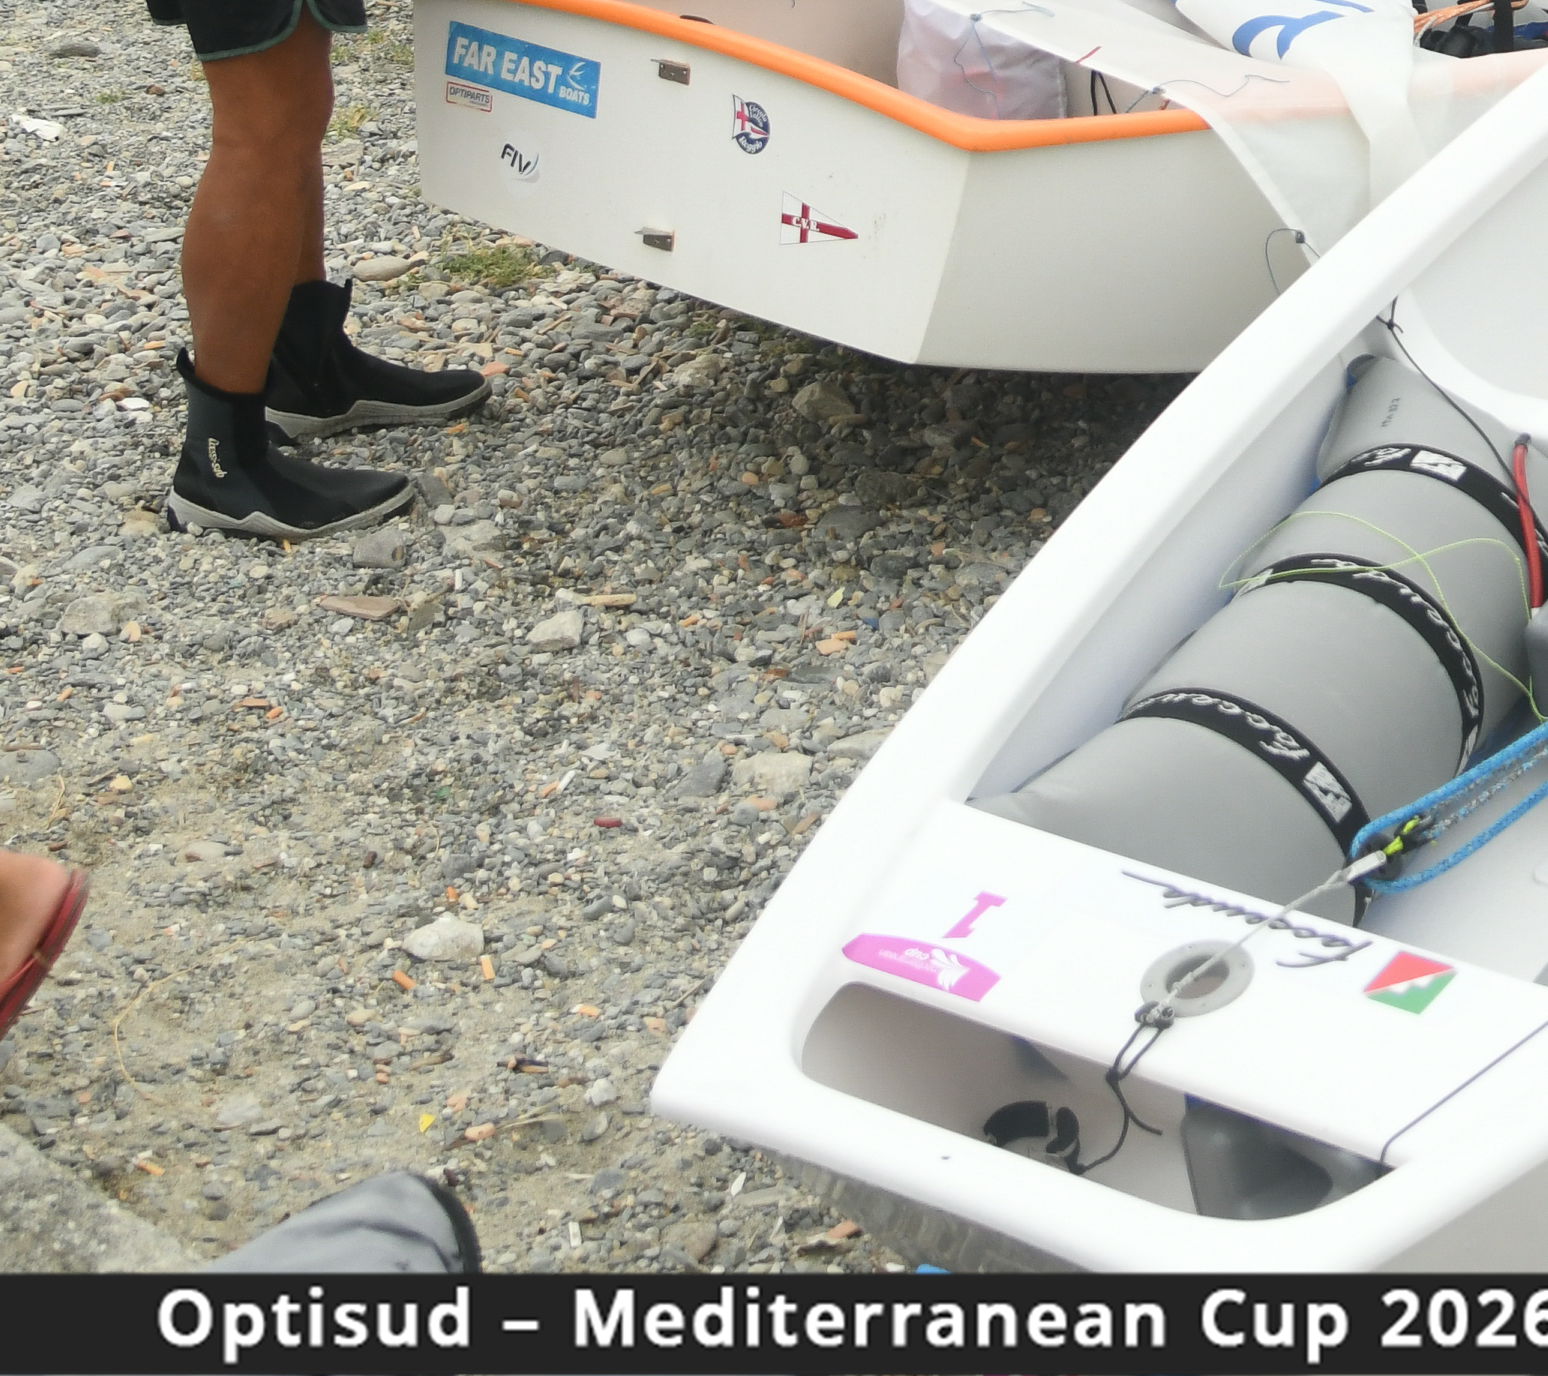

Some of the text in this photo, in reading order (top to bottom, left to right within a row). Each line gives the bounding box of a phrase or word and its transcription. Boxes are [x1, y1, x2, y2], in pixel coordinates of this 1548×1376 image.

[453, 36, 563, 94] FAR EAST
[449, 86, 490, 105] OPTIPARTS
[558, 85, 591, 106] BOATS
[500, 143, 532, 173] FIV
[791, 216, 820, 232] C.V.R.
[941, 890, 1009, 939] 1
